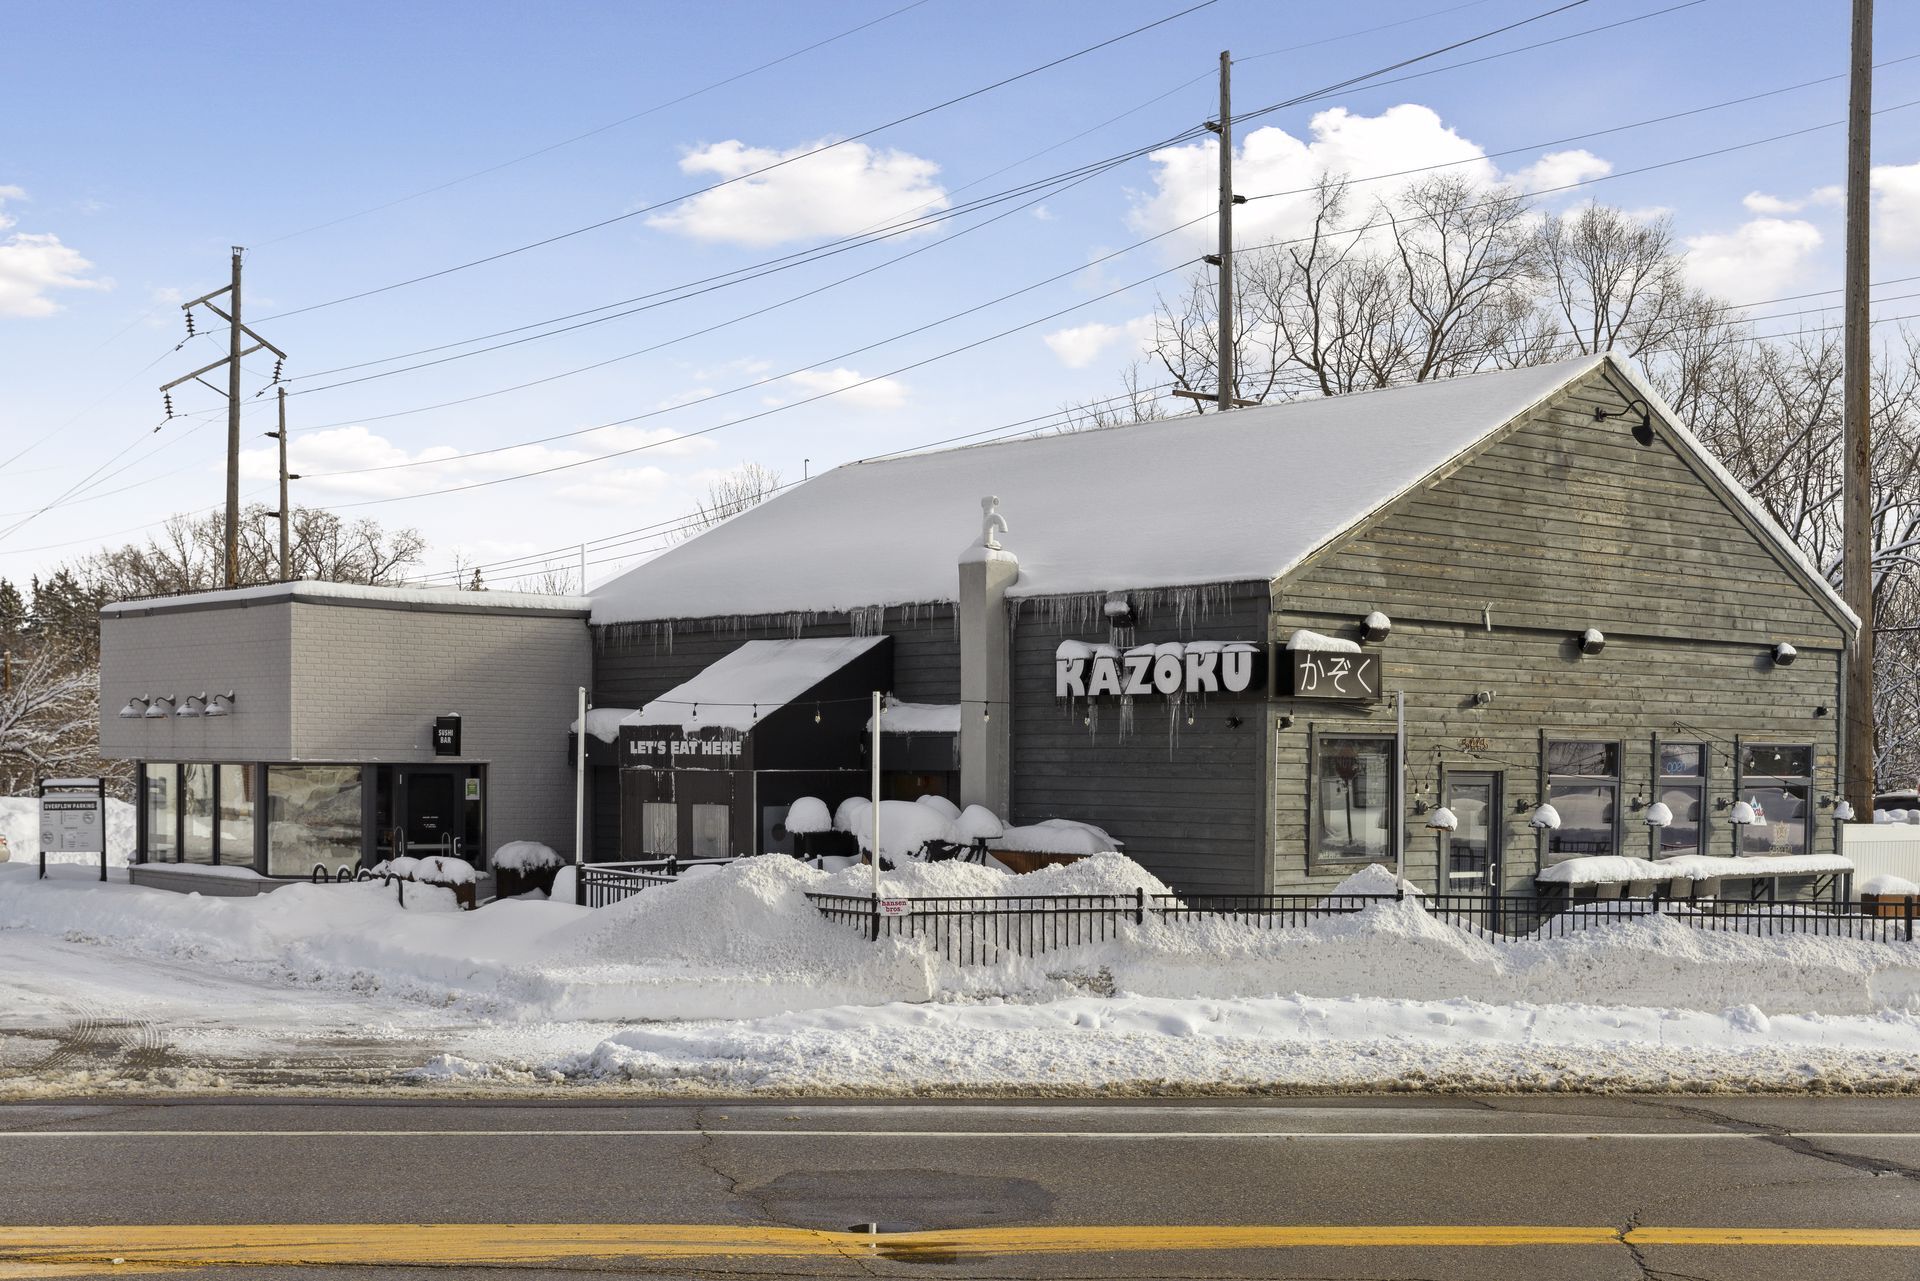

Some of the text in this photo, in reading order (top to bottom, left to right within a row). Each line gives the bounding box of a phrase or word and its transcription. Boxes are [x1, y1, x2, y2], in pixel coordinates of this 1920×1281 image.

[1056, 651, 1252, 697] KAZOKU
[1300, 653, 1372, 693] かぞく
[438, 729, 454, 737] SUSHI
[440, 736, 452, 744] BAR
[630, 740, 742, 755] LET'S EAT HERE
